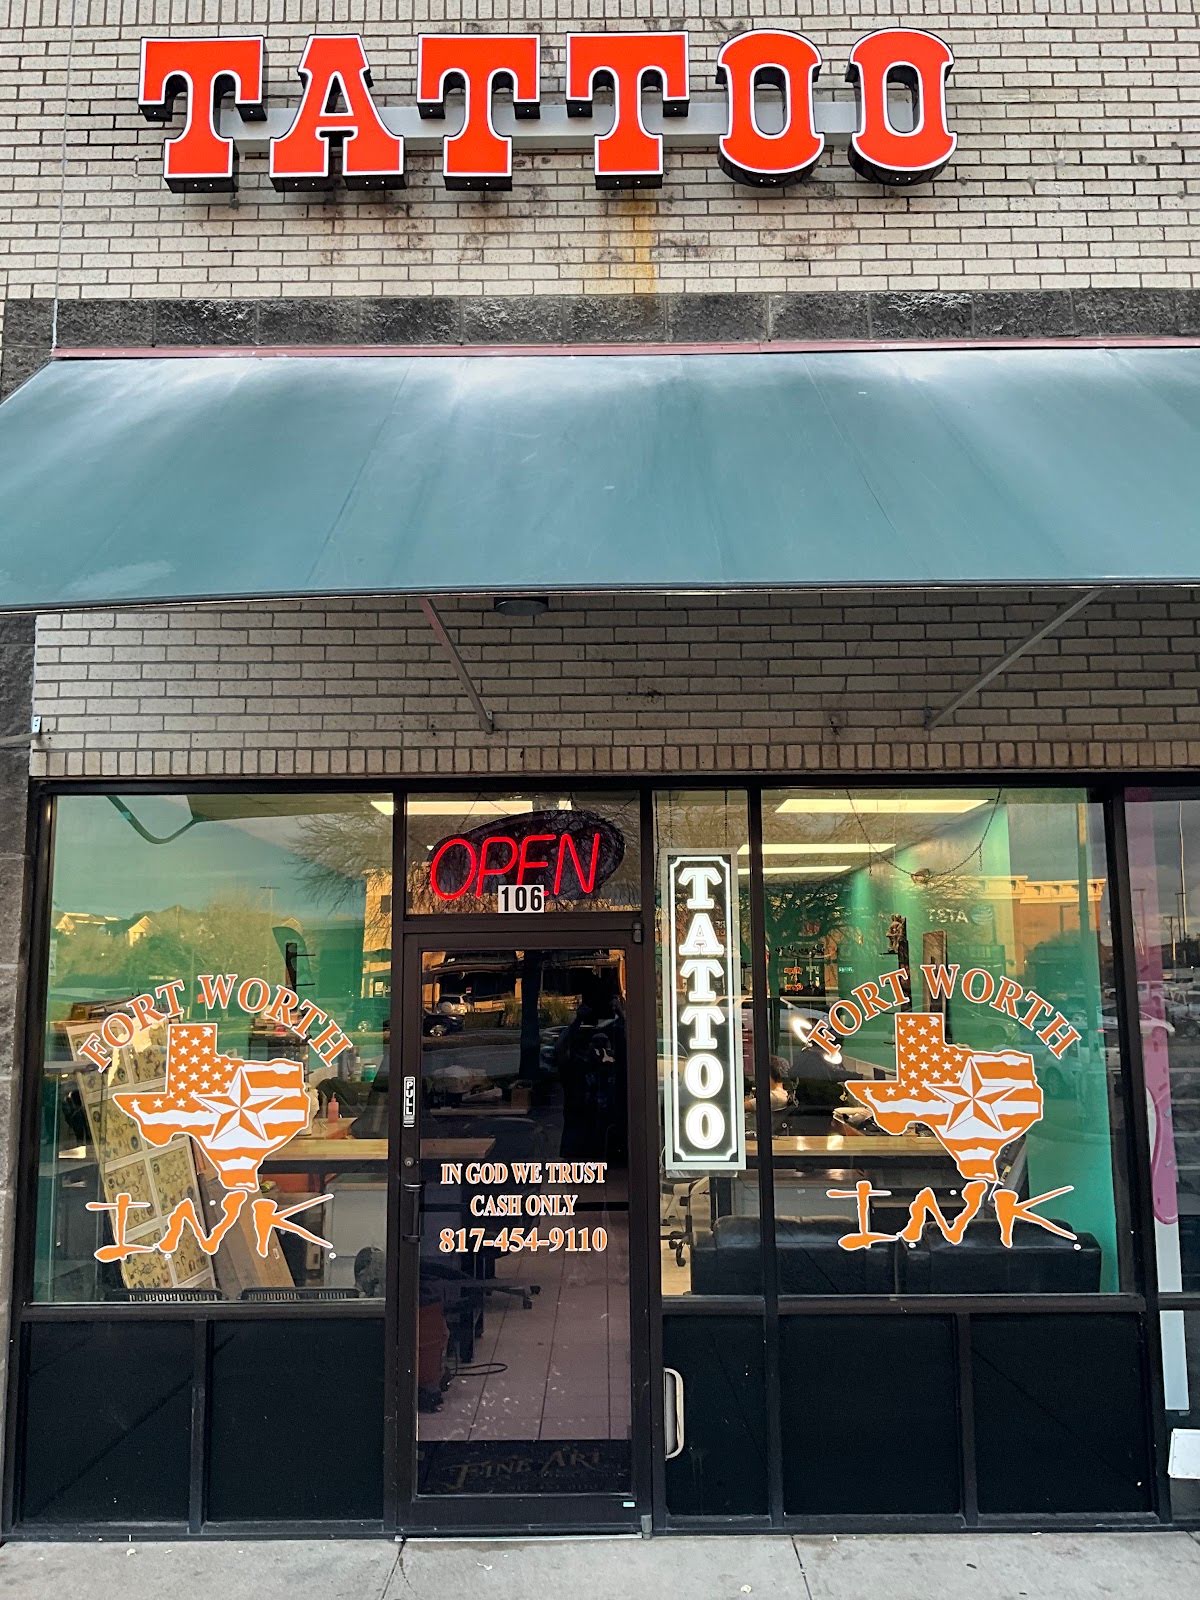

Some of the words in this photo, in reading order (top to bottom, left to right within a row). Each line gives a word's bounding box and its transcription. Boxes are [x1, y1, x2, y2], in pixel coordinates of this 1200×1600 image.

[137, 27, 958, 185] TATTOO
[430, 832, 601, 901] OPEN
[500, 885, 543, 912] 106
[78, 980, 186, 1074] FORT
[198, 974, 354, 1068] WORTH
[677, 866, 726, 1151] TATTOO
[807, 967, 911, 1062] FORT
[920, 964, 1083, 1060] WORTH
[405, 1081, 414, 1115] PULL
[439, 1163, 463, 1185] IN
[465, 1163, 509, 1185] GOD
[511, 1162, 543, 1184] WE
[545, 1162, 608, 1184] TRUST
[470, 1194, 523, 1217] CASH
[525, 1194, 579, 1216] ONLY
[86, 1189, 335, 1263] INK
[438, 1226, 608, 1253] 817-454-9110
[826, 1179, 1079, 1251] INK
